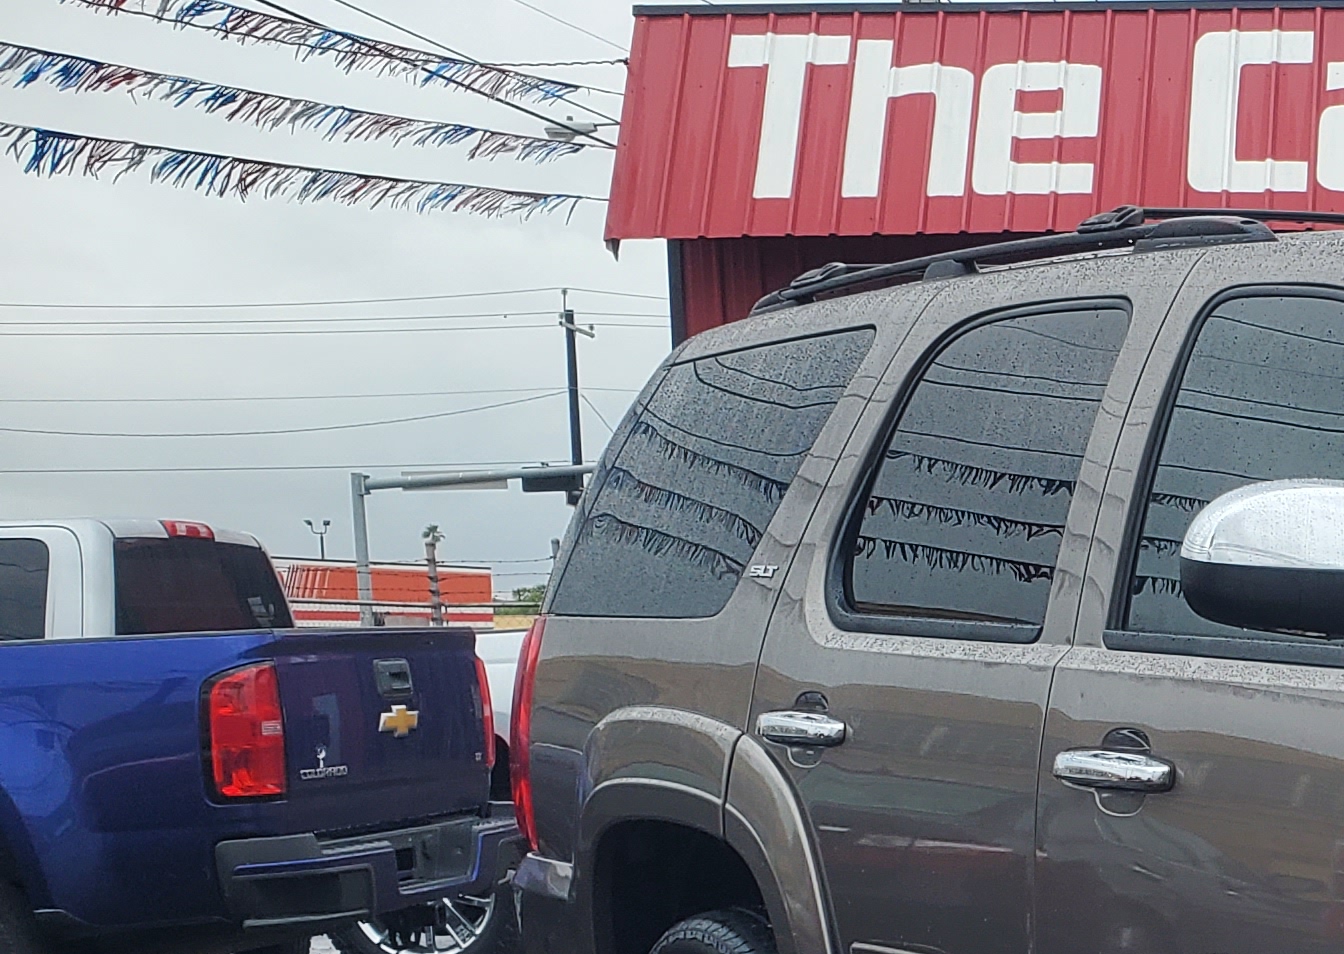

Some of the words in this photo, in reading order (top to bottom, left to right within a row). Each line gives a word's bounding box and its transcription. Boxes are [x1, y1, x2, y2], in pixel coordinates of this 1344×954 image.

[727, 32, 1102, 199] The
[748, 564, 780, 579] SLT
[300, 766, 348, 779] COLORADO
